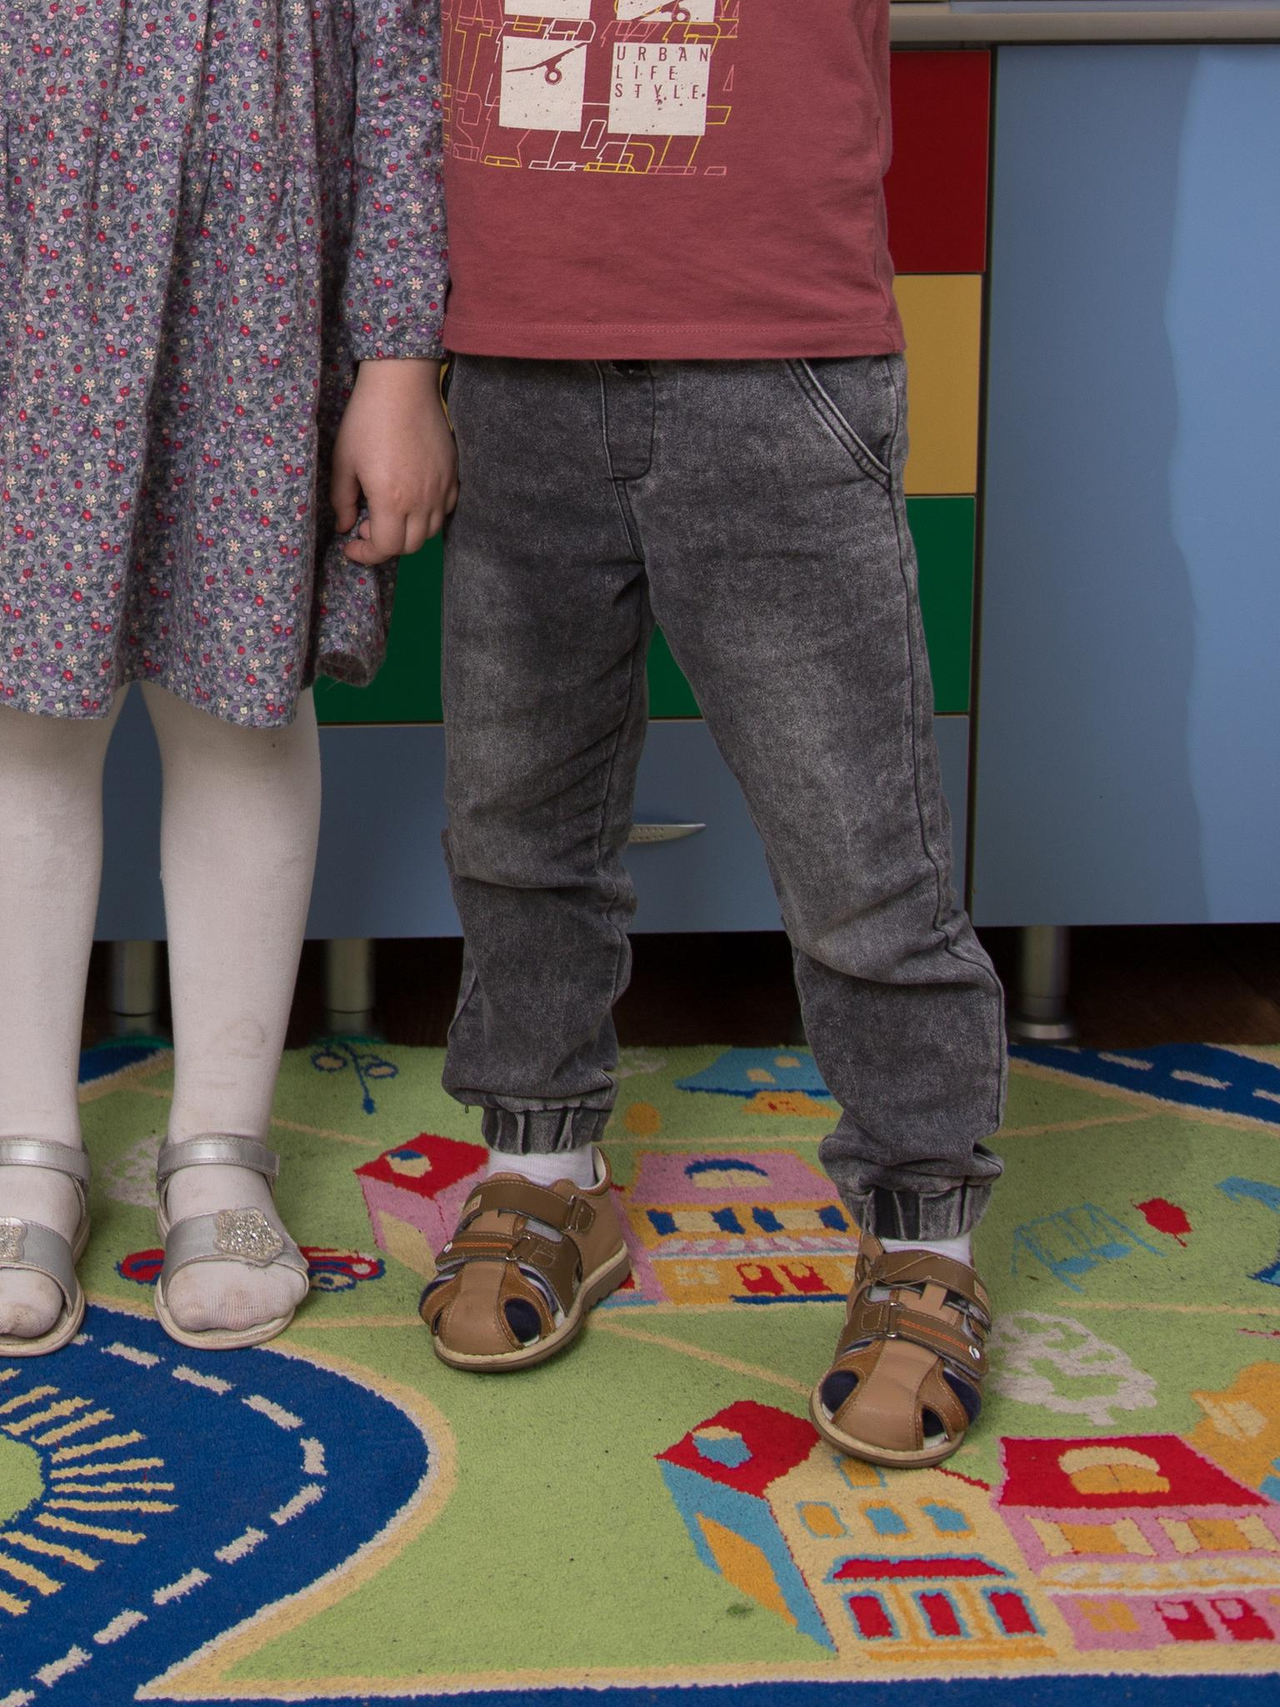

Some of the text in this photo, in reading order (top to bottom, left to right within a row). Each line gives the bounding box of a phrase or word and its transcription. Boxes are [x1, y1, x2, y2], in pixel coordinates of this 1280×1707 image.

[616, 47, 709, 62] URBAN
[616, 65, 676, 80] LIFE
[615, 84, 699, 99] STYLE
